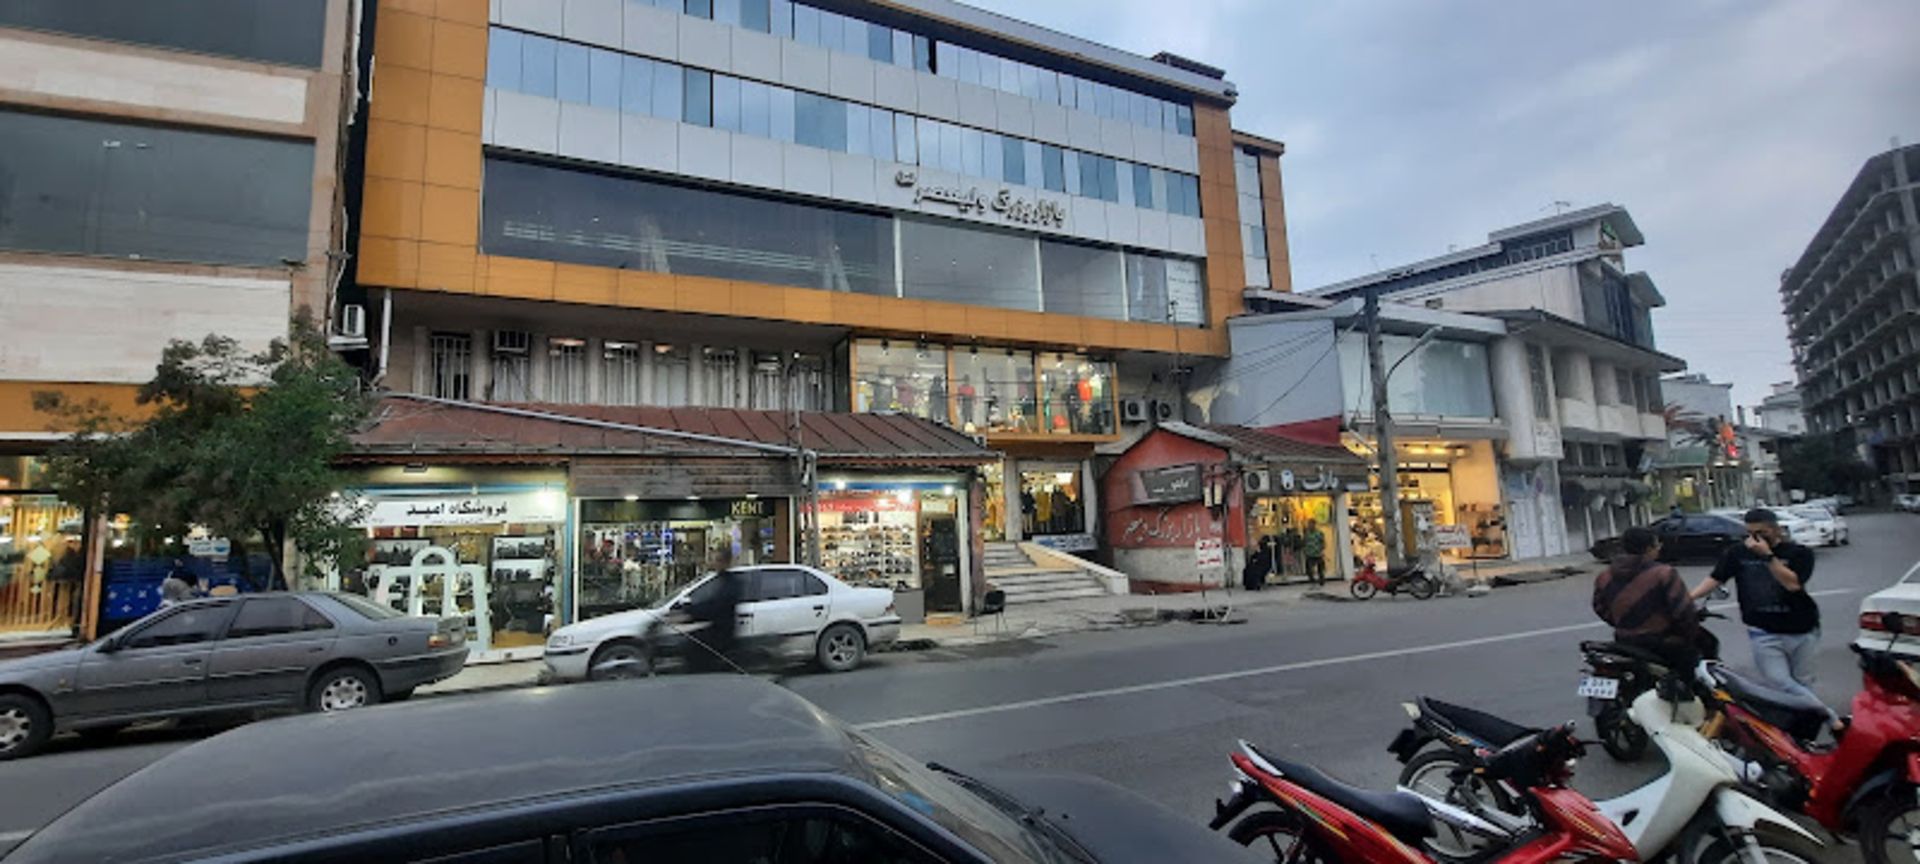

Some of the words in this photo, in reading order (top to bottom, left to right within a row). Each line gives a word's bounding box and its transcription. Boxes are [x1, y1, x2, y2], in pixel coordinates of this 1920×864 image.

[991, 189, 1031, 224] بزرگ
[1032, 199, 1065, 229] بازار
[406, 502, 445, 518] امید
[448, 500, 508, 518] فروشگاه
[731, 500, 764, 515] KENT
